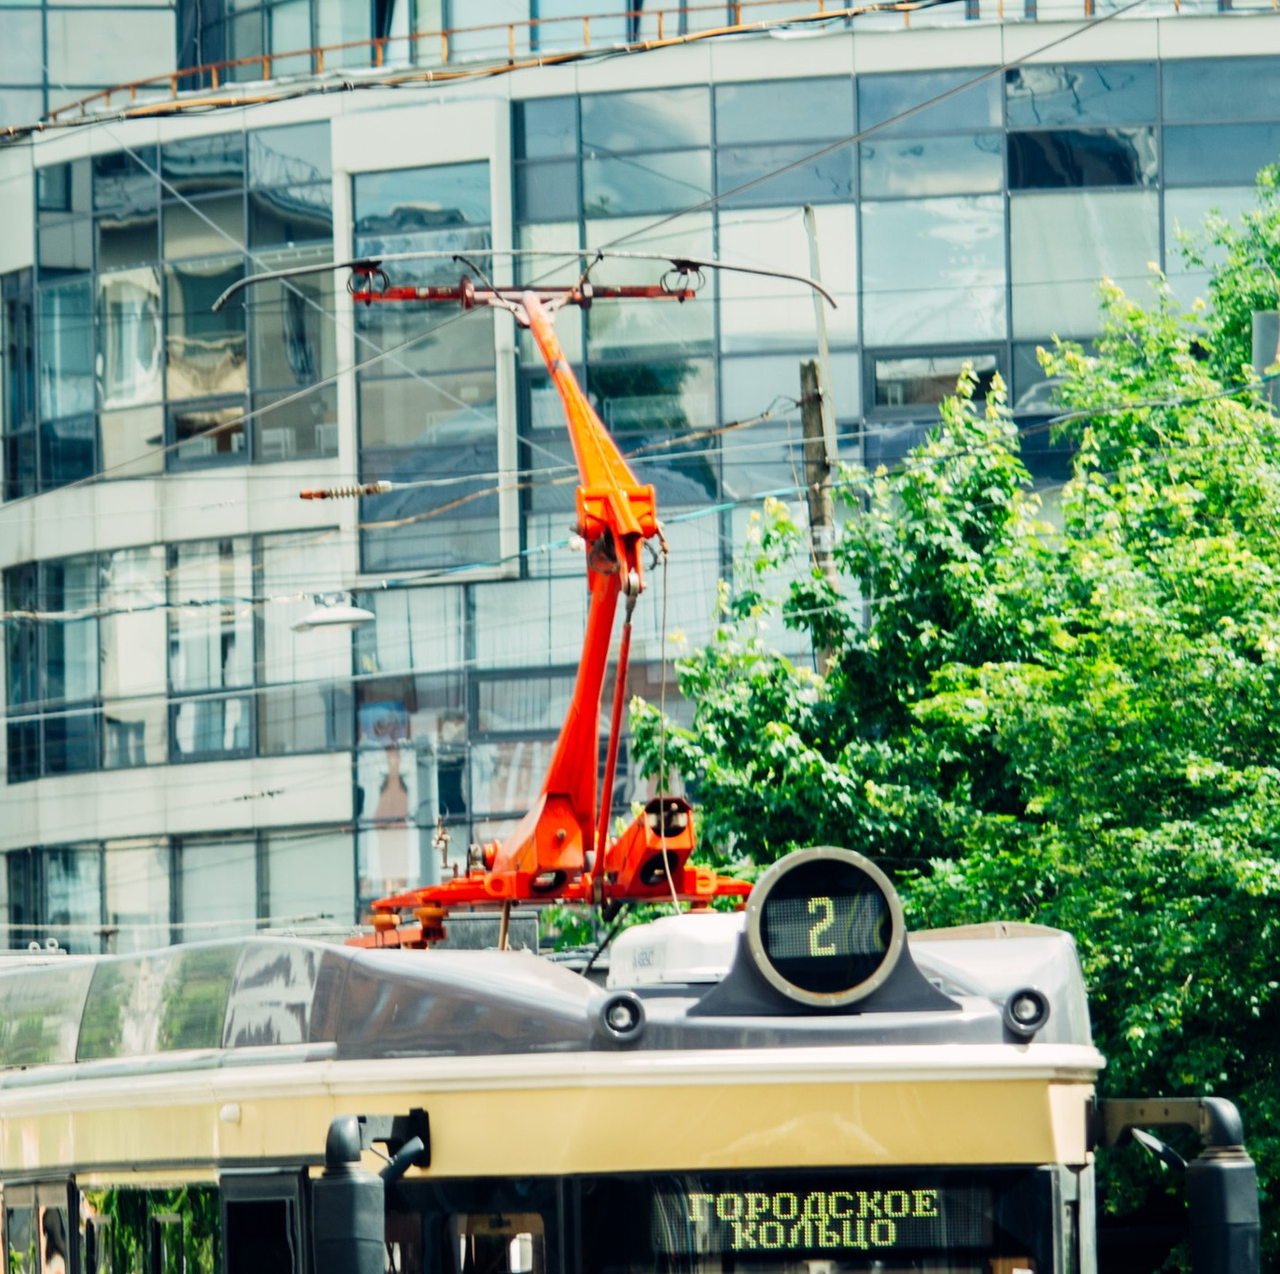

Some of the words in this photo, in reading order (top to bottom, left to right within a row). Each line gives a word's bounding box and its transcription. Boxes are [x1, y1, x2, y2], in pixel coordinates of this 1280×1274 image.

[807, 896, 836, 957] 2
[688, 1190, 938, 1225] ГОРОДСКОЕ
[731, 1219, 897, 1250] КОЛЬЦО
